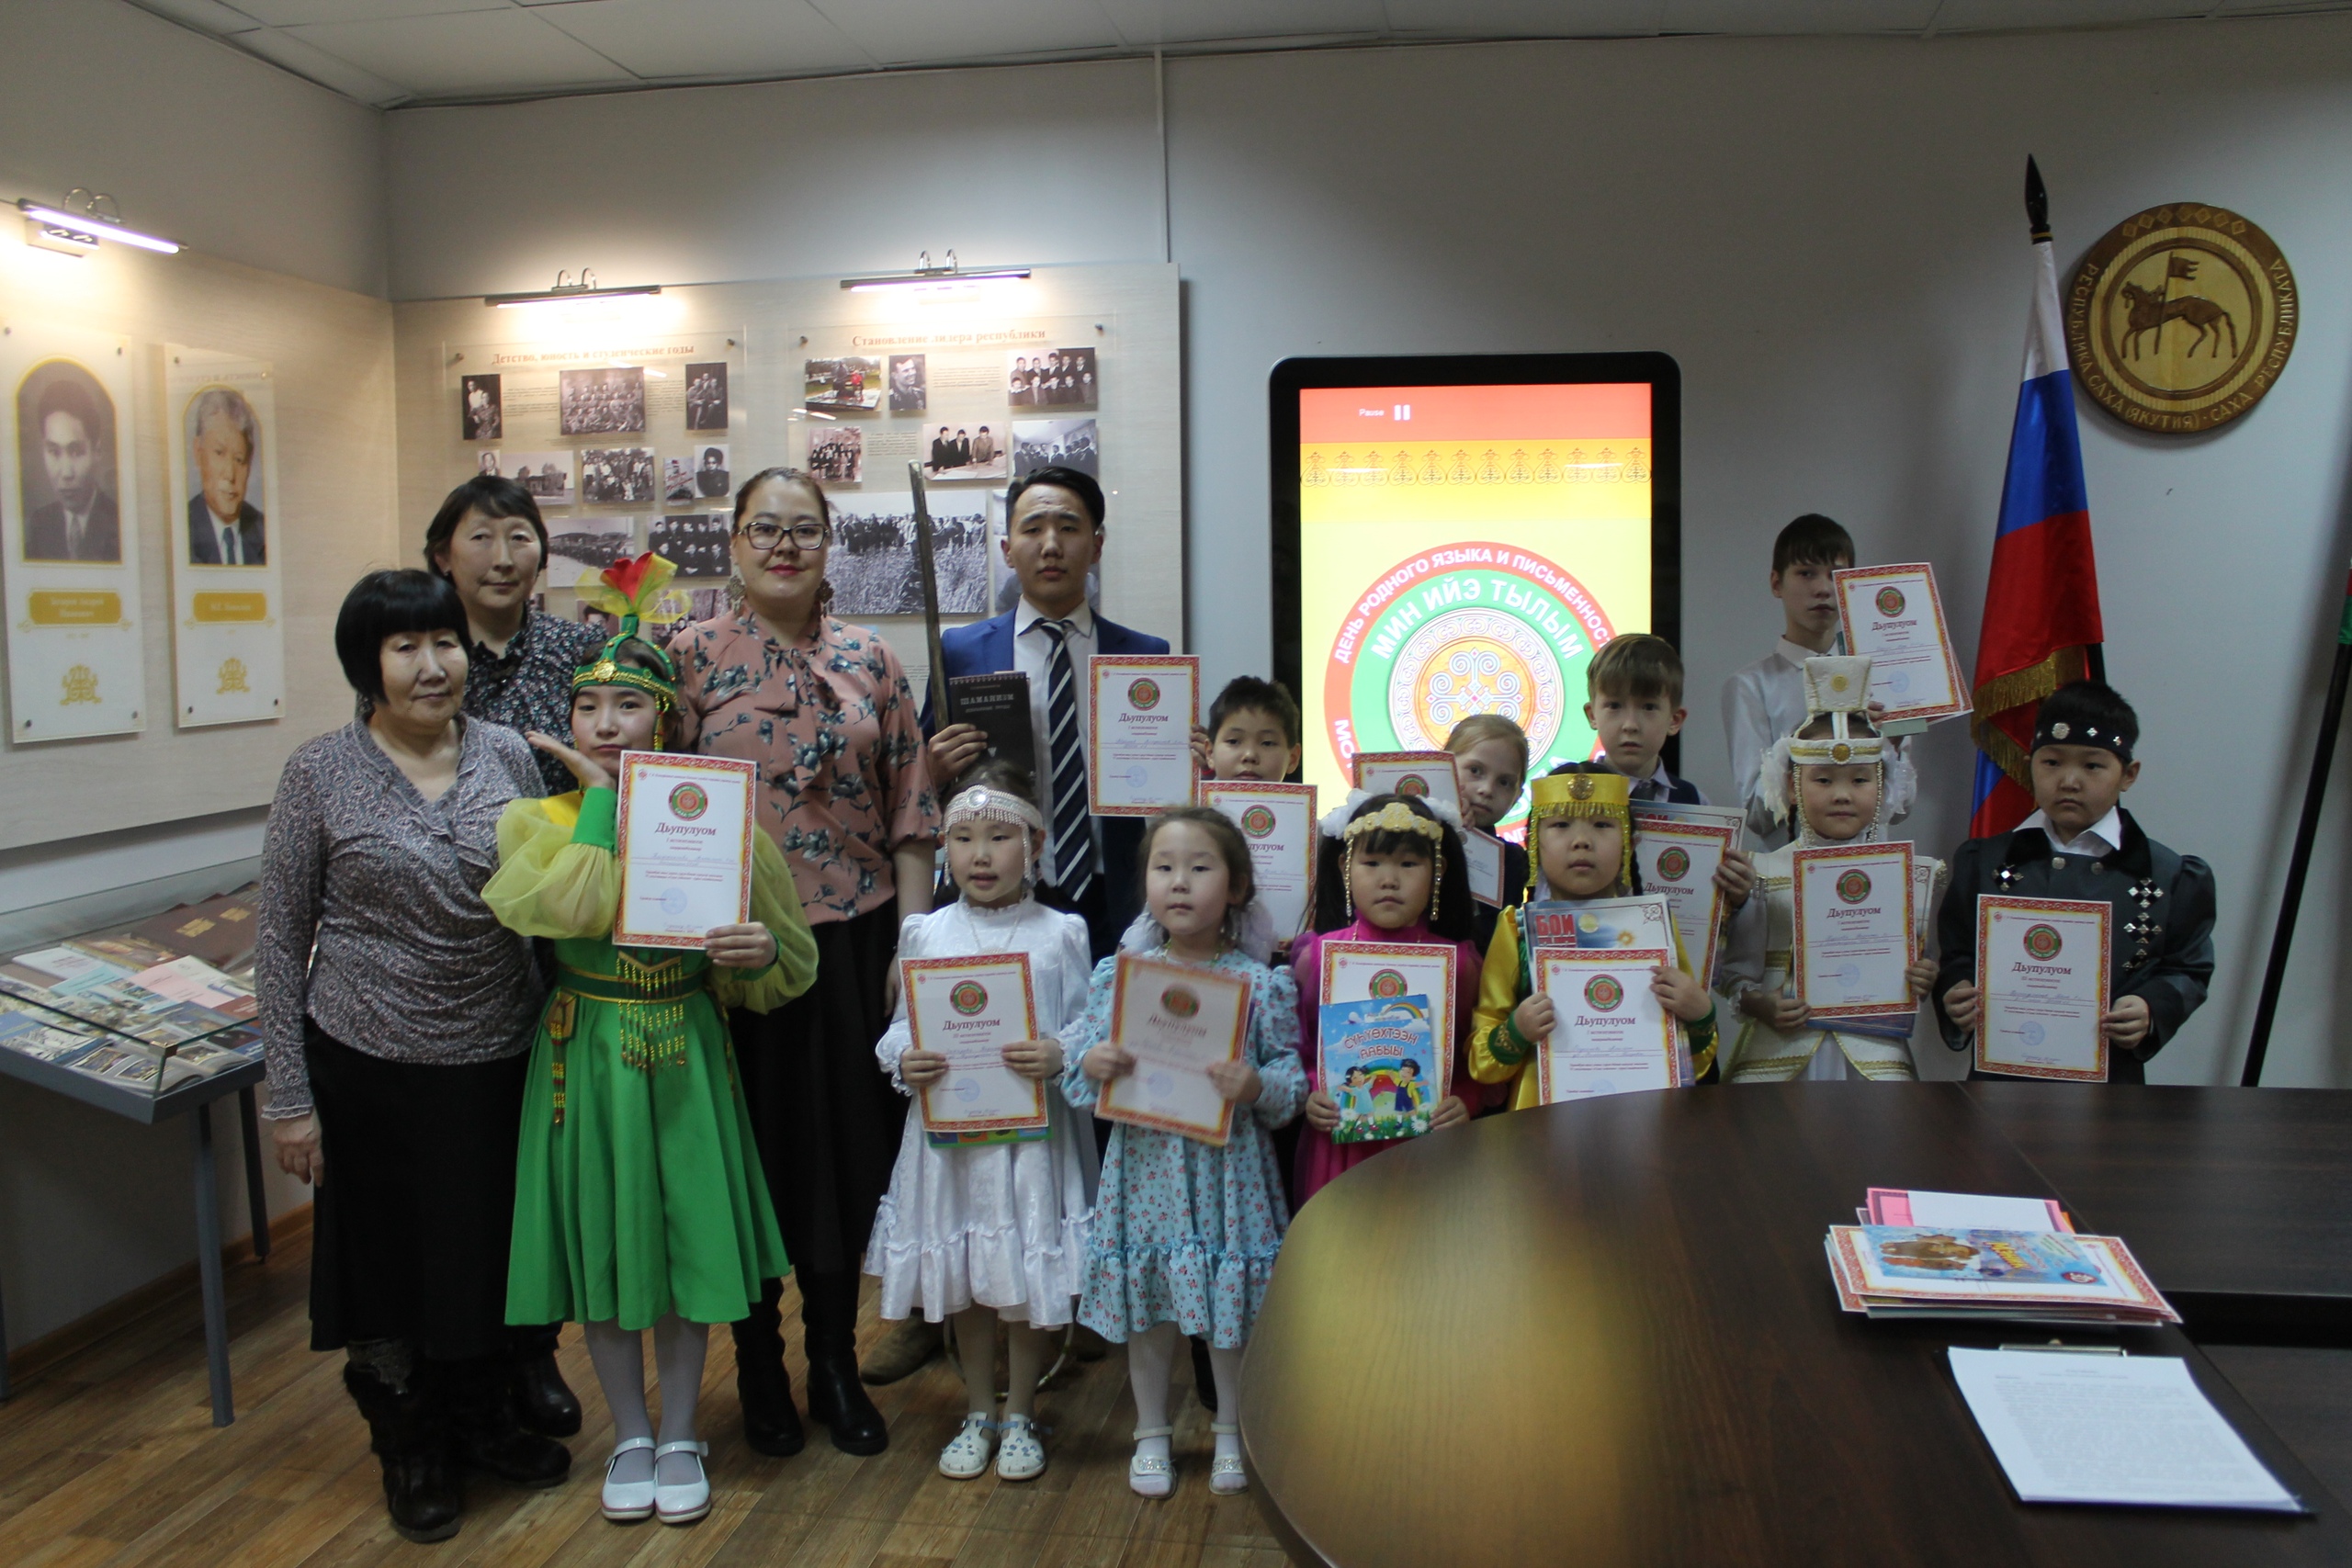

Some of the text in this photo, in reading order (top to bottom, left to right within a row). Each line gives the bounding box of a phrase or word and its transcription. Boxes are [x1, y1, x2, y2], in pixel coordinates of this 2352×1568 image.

[852, 334, 928, 347] Становление
[976, 329, 1046, 344] республики
[2211, 258, 2294, 422] САХА РЕСПУБЛИКАТА
[2069, 264, 2199, 429] РЕСПУБЛИКА САХА (ЯКУТИЯ)
[492, 353, 537, 365] Детство,
[668, 344, 695, 355] годы
[1359, 408, 1385, 417] Pause
[1334, 620, 1364, 664] ДЕНЬ
[1362, 558, 1430, 617] РОДНОГО
[1431, 547, 1493, 568] ЯЗЫКА
[1497, 551, 1510, 564] И
[1370, 578, 1586, 660] МИН ИЙЭ ТЫЛЫМ
[1118, 713, 1169, 723] Дьупулуом
[655, 822, 717, 837] Дьупулуом
[1644, 882, 1694, 896] Дьупулуом
[1826, 907, 1882, 919] Дьупулуом
[2012, 962, 2072, 976] Дьупулуом
[943, 1018, 1001, 1032] Дьупулуом
[1575, 1015, 1635, 1027] Дьупулуом
